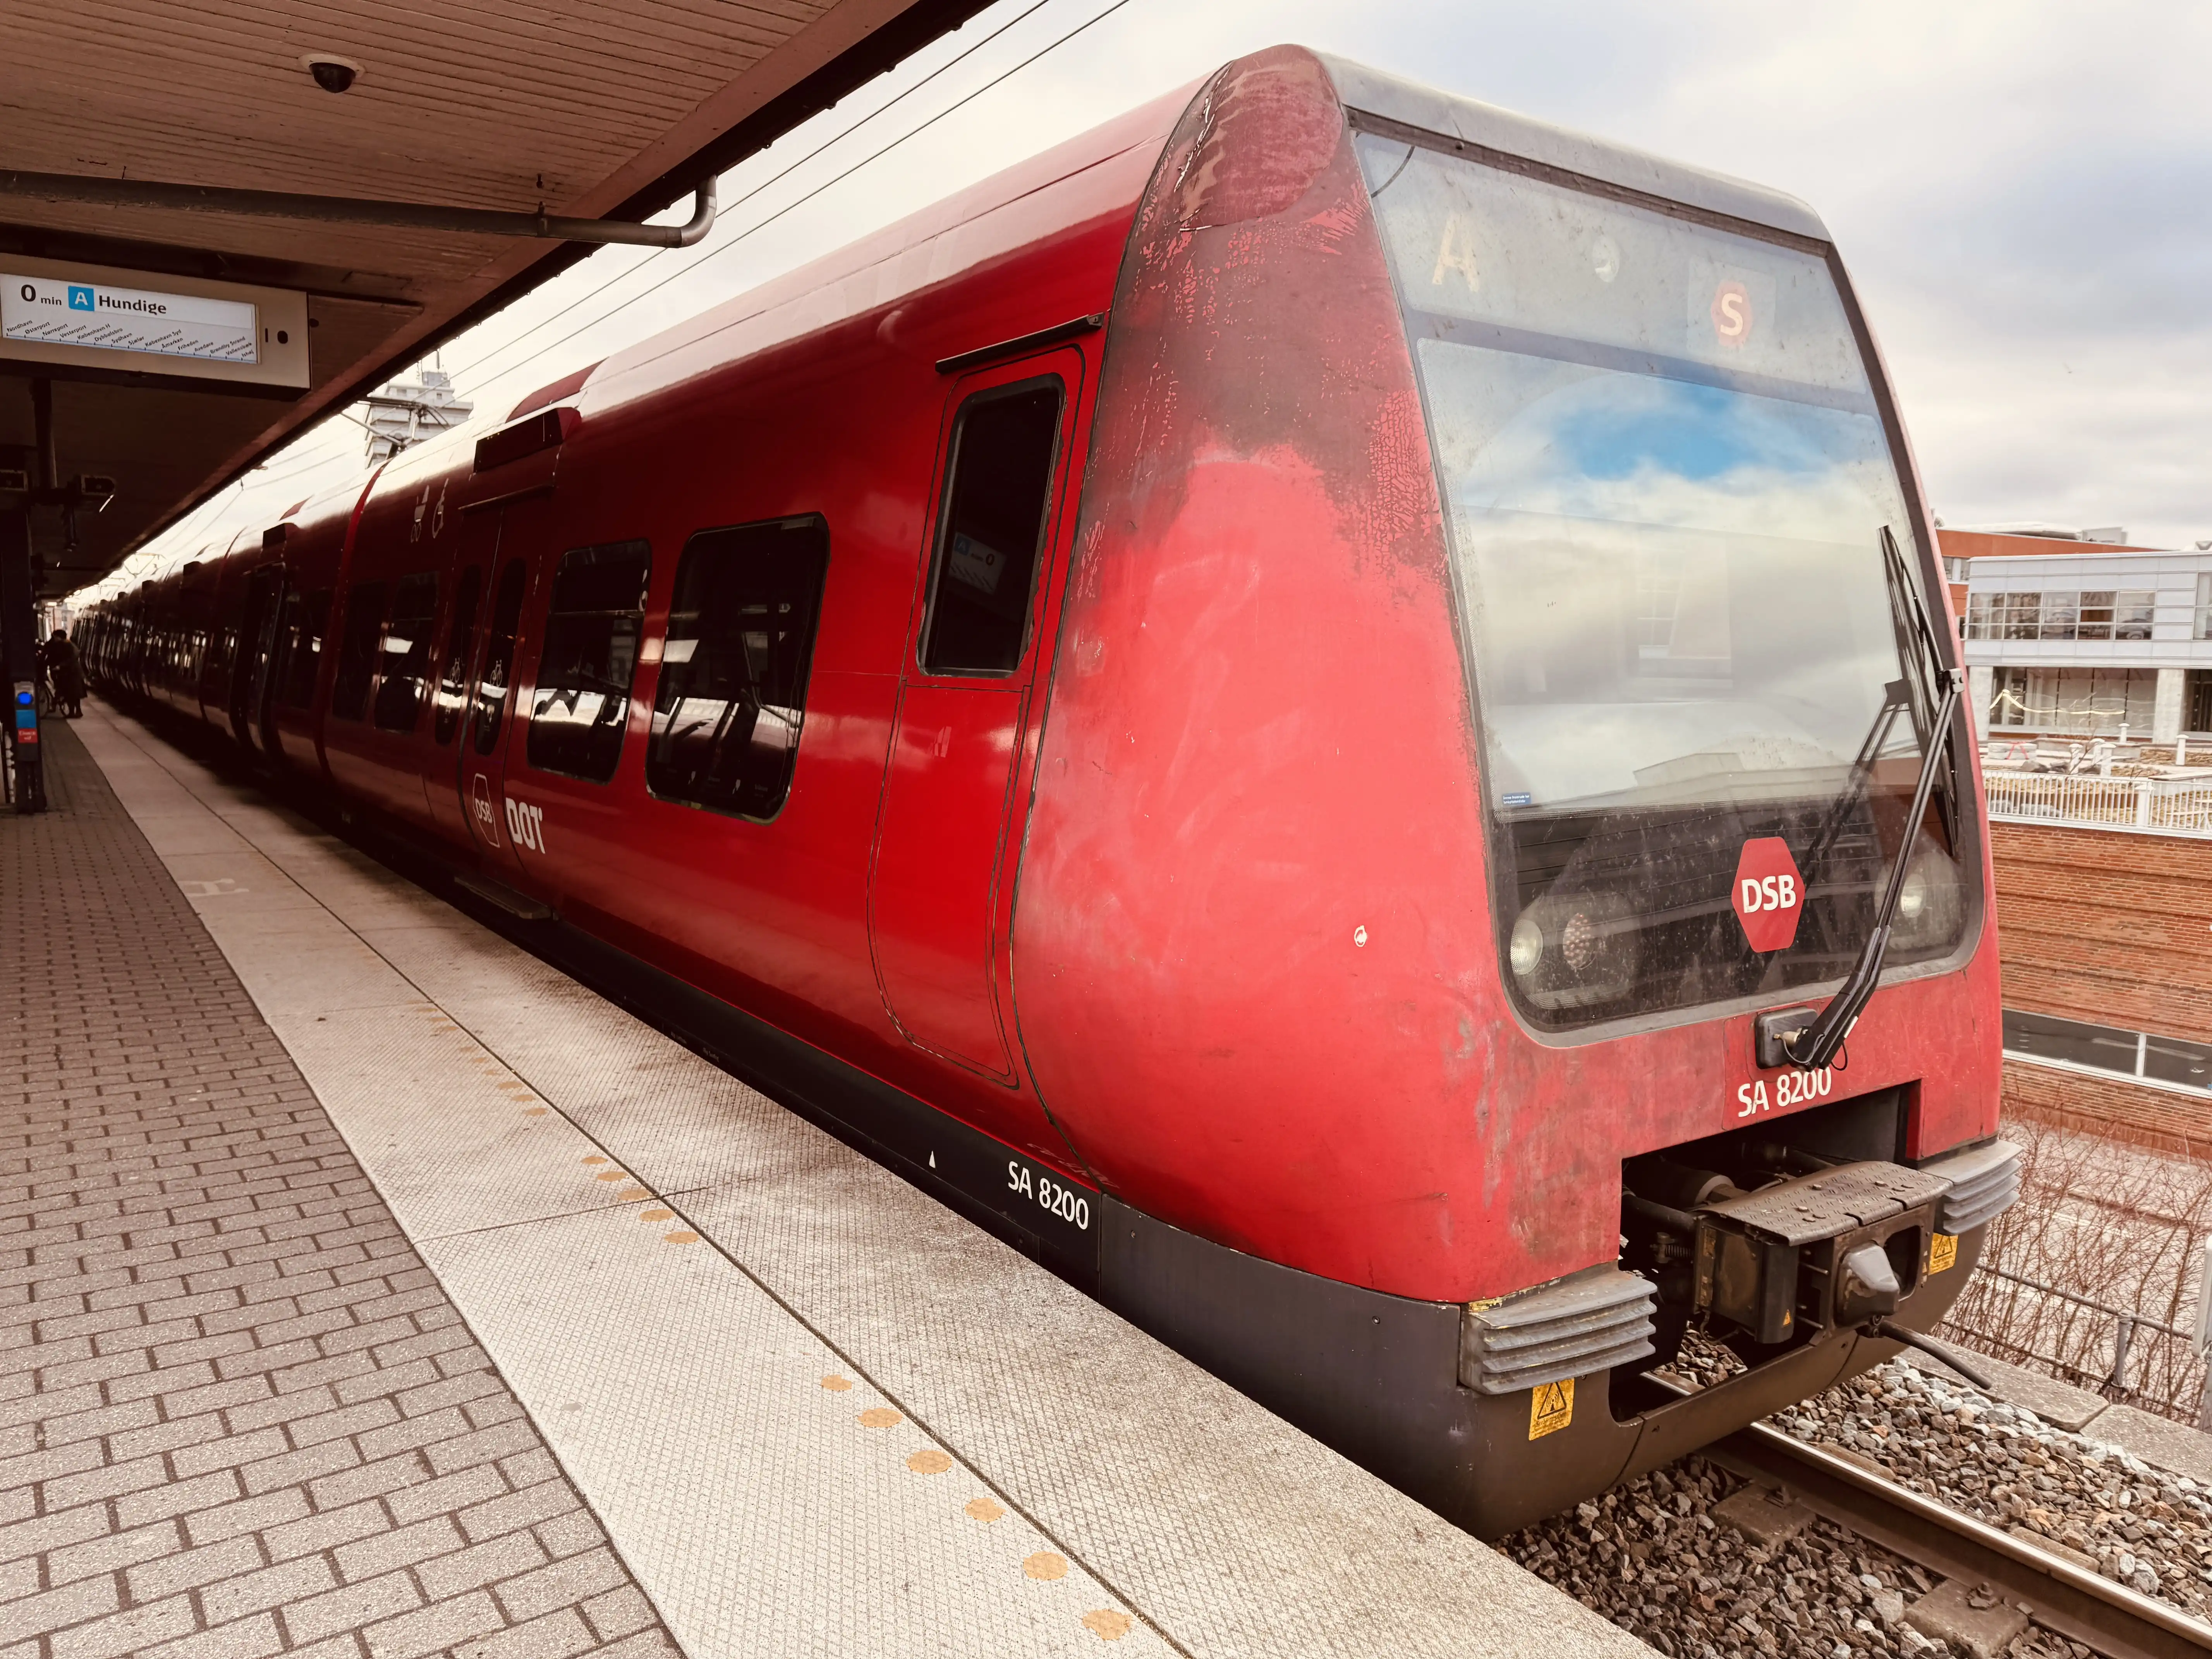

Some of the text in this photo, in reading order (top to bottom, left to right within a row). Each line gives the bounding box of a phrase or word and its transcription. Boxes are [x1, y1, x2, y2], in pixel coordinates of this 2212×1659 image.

[1431, 213, 1480, 292] A
[21, 284, 167, 315] 0 min A Hundige
[1719, 292, 1744, 336] S
[7, 320, 33, 332] Nordhavn
[60, 325, 87, 338] Vesterport
[474, 798, 493, 824] DSB
[1741, 874, 1796, 914] DSB
[1738, 1066, 1832, 1118] SA 8200
[1008, 1161, 1089, 1230] SA 8200
